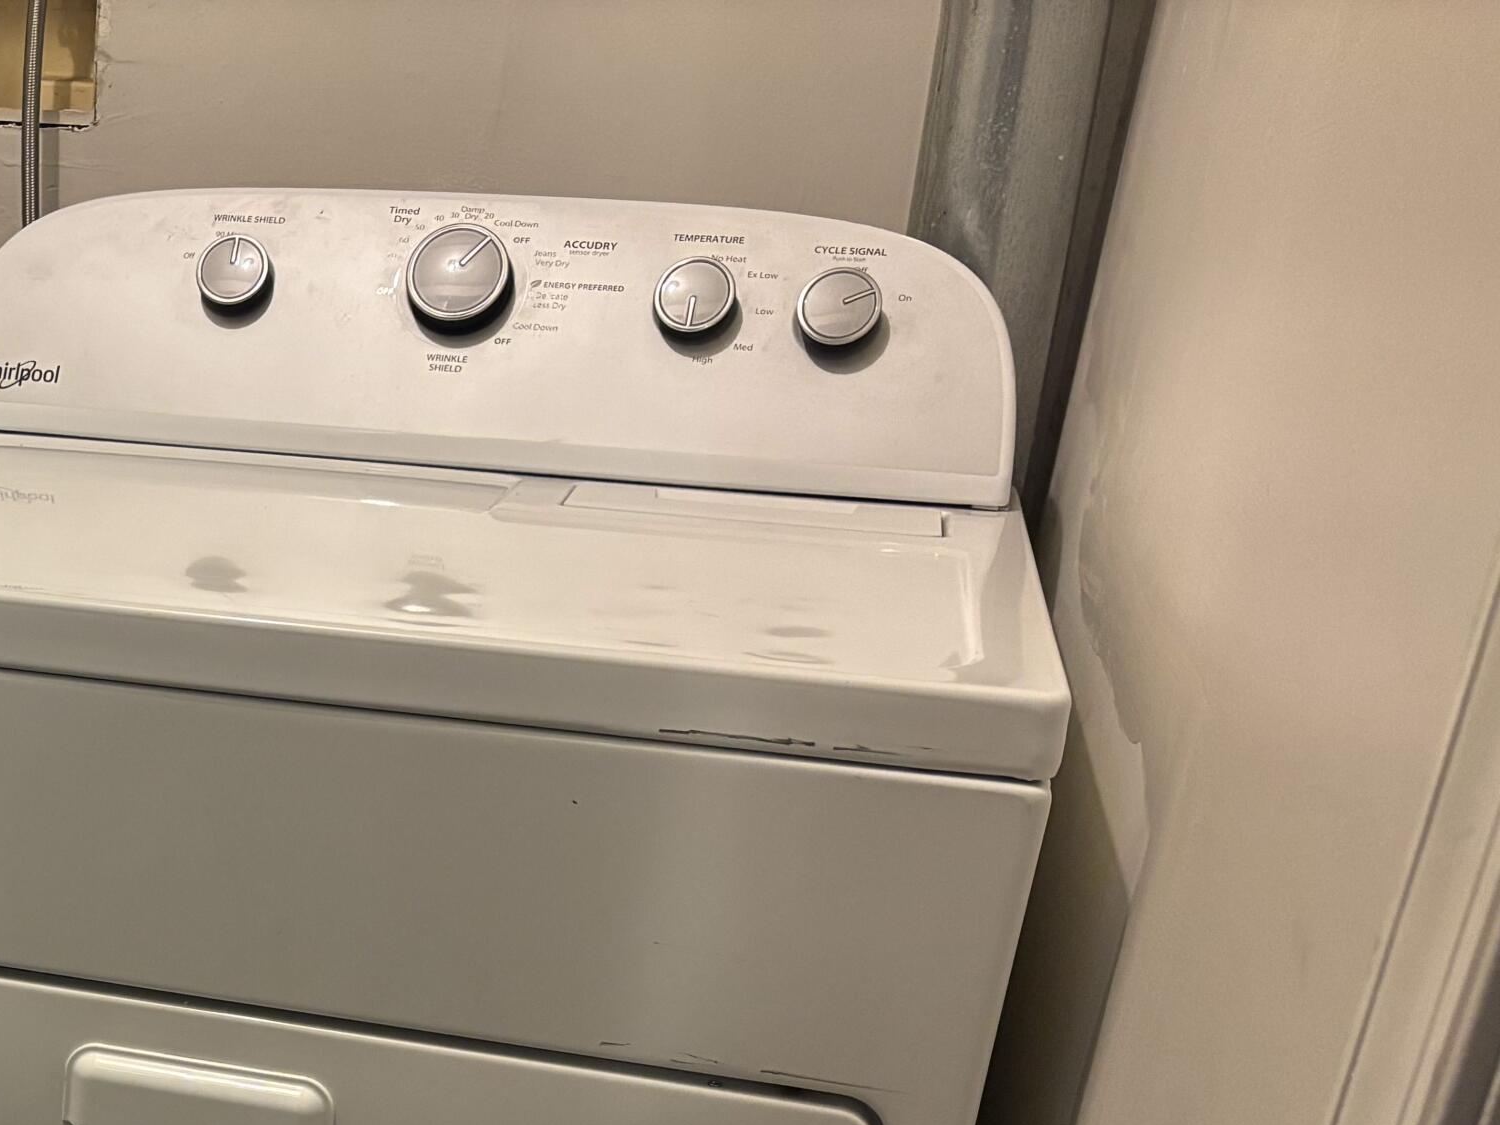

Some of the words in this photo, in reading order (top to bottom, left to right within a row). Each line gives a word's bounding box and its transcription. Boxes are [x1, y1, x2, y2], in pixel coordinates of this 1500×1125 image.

[389, 206, 421, 216] Timed
[461, 205, 485, 214] Damp
[214, 214, 253, 223] WRINKLE
[254, 216, 286, 225] SHIELD
[394, 215, 412, 226] Dry
[434, 214, 445, 222] 40
[464, 212, 479, 221] Dry
[484, 212, 495, 220] 20
[494, 219, 513, 227] Cool
[514, 220, 539, 228] Down
[513, 236, 531, 244] OFF
[674, 233, 745, 245] TEMPERATURE
[563, 240, 618, 251] ACCUDRY
[814, 245, 847, 255] CYCLE
[849, 247, 888, 257] SIGNAL
[555, 260, 570, 268] Dry
[726, 255, 747, 264] Heat
[747, 270, 757, 279] Ex
[760, 272, 779, 280] Low
[543, 281, 576, 290] ENERGY
[577, 283, 625, 293] PREFERRED
[898, 294, 912, 302] On
[551, 302, 566, 311] Dry
[755, 307, 774, 315] Low
[512, 321, 532, 331] Cool
[533, 323, 558, 332] Down
[733, 343, 754, 351] Med
[426, 353, 468, 364] WRINKLE
[692, 355, 713, 365] High
[428, 364, 462, 373] SHIELD
